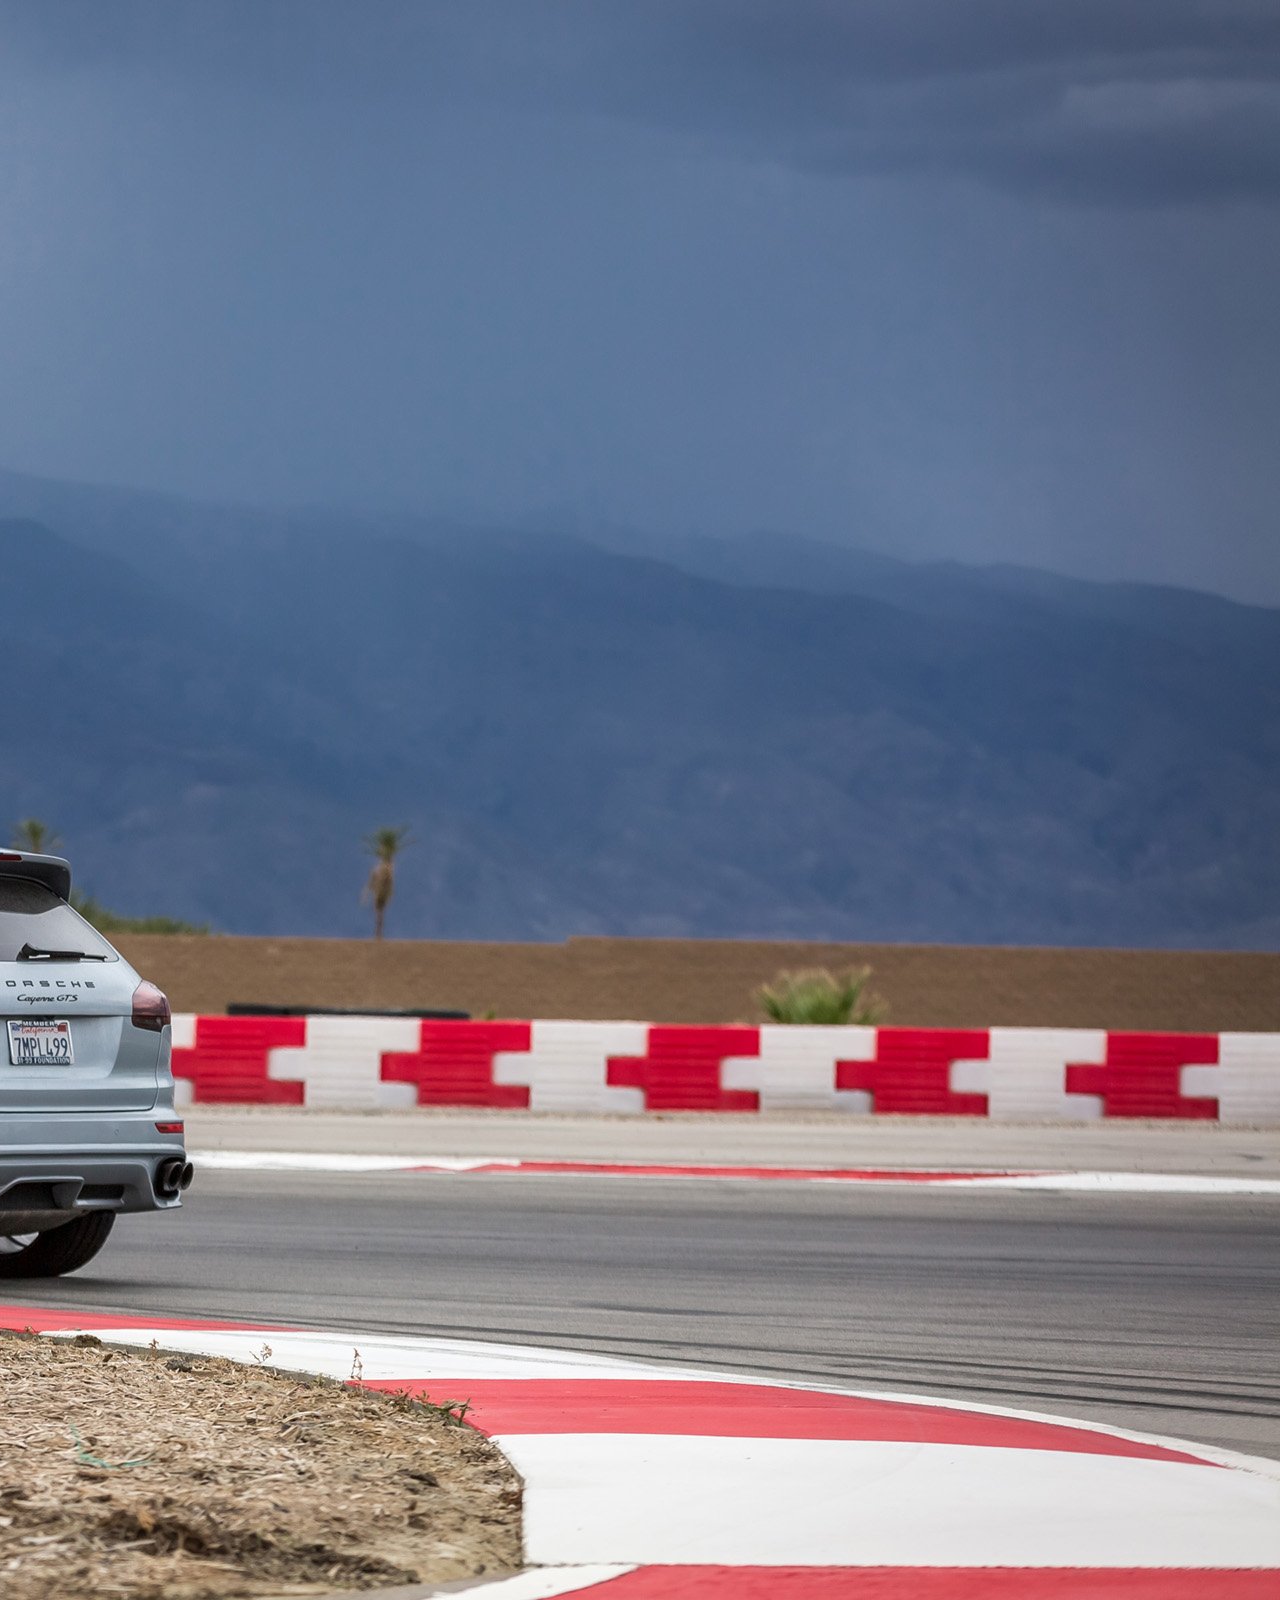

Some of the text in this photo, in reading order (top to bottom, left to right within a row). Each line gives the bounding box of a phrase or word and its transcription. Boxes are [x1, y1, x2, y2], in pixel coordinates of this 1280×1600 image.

[17, 994, 78, 1005] Cayenne GTS
[22, 1026, 58, 1036] California
[14, 1037, 68, 1057] 7MPL499
